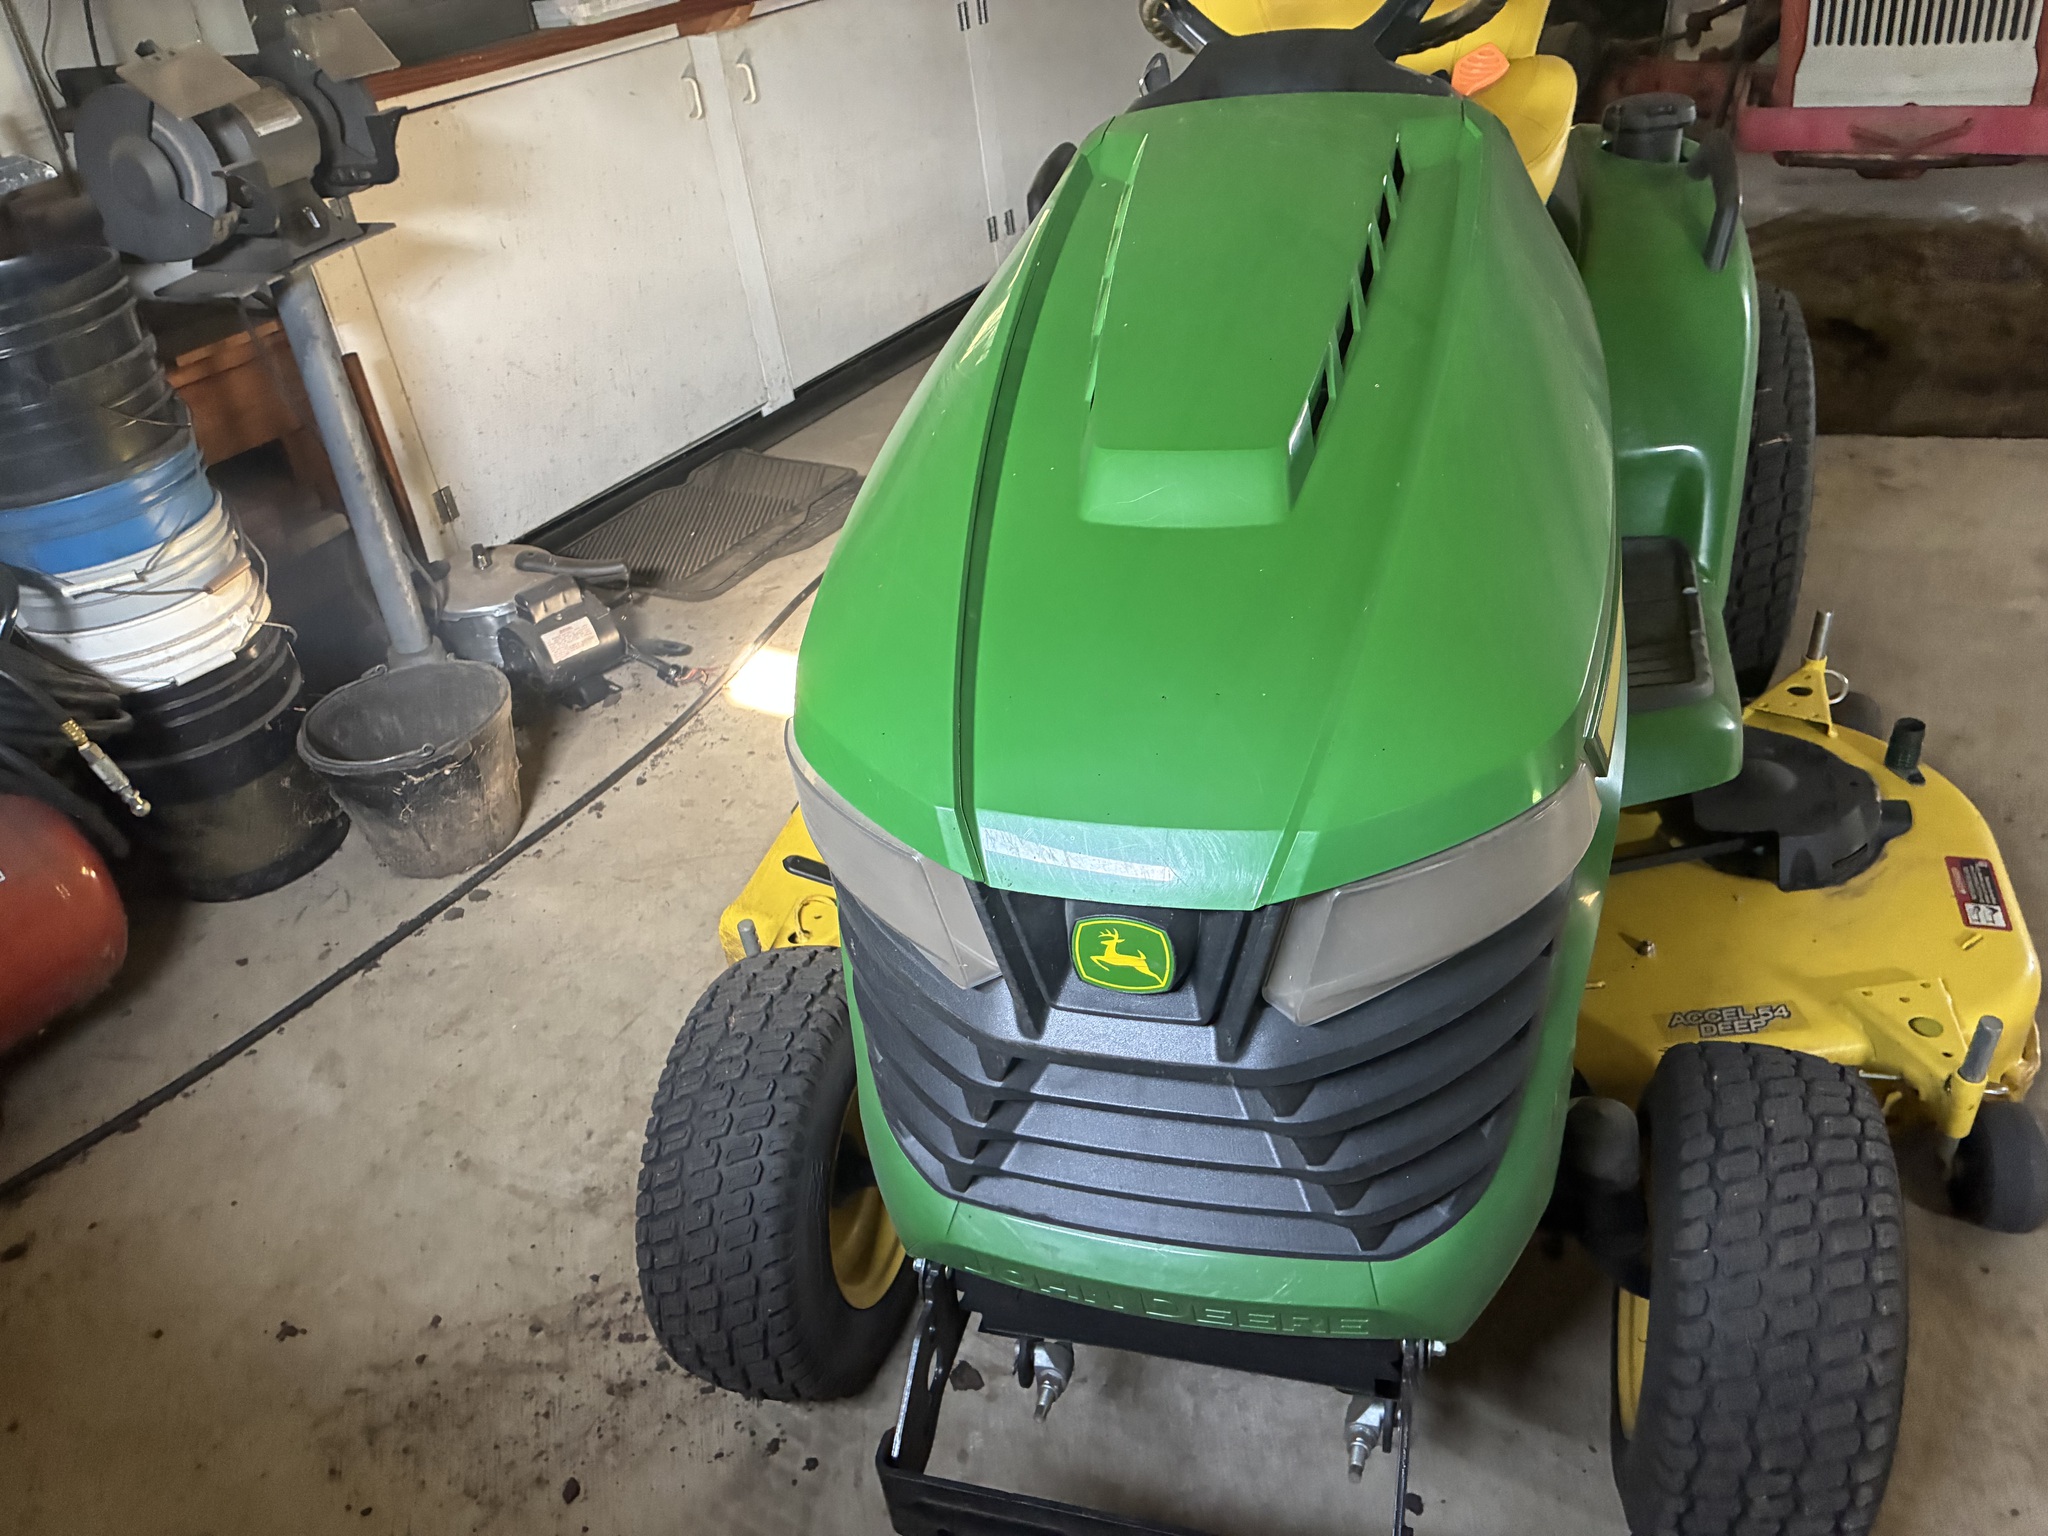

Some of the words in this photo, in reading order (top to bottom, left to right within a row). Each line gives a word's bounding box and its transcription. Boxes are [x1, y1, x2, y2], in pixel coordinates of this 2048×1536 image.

[1669, 1006, 1754, 1028] ACCEL
[1756, 1004, 1791, 1021] 54
[1700, 1019, 1767, 1038] DEEP
[1140, 1292, 1369, 1335] DEERE
